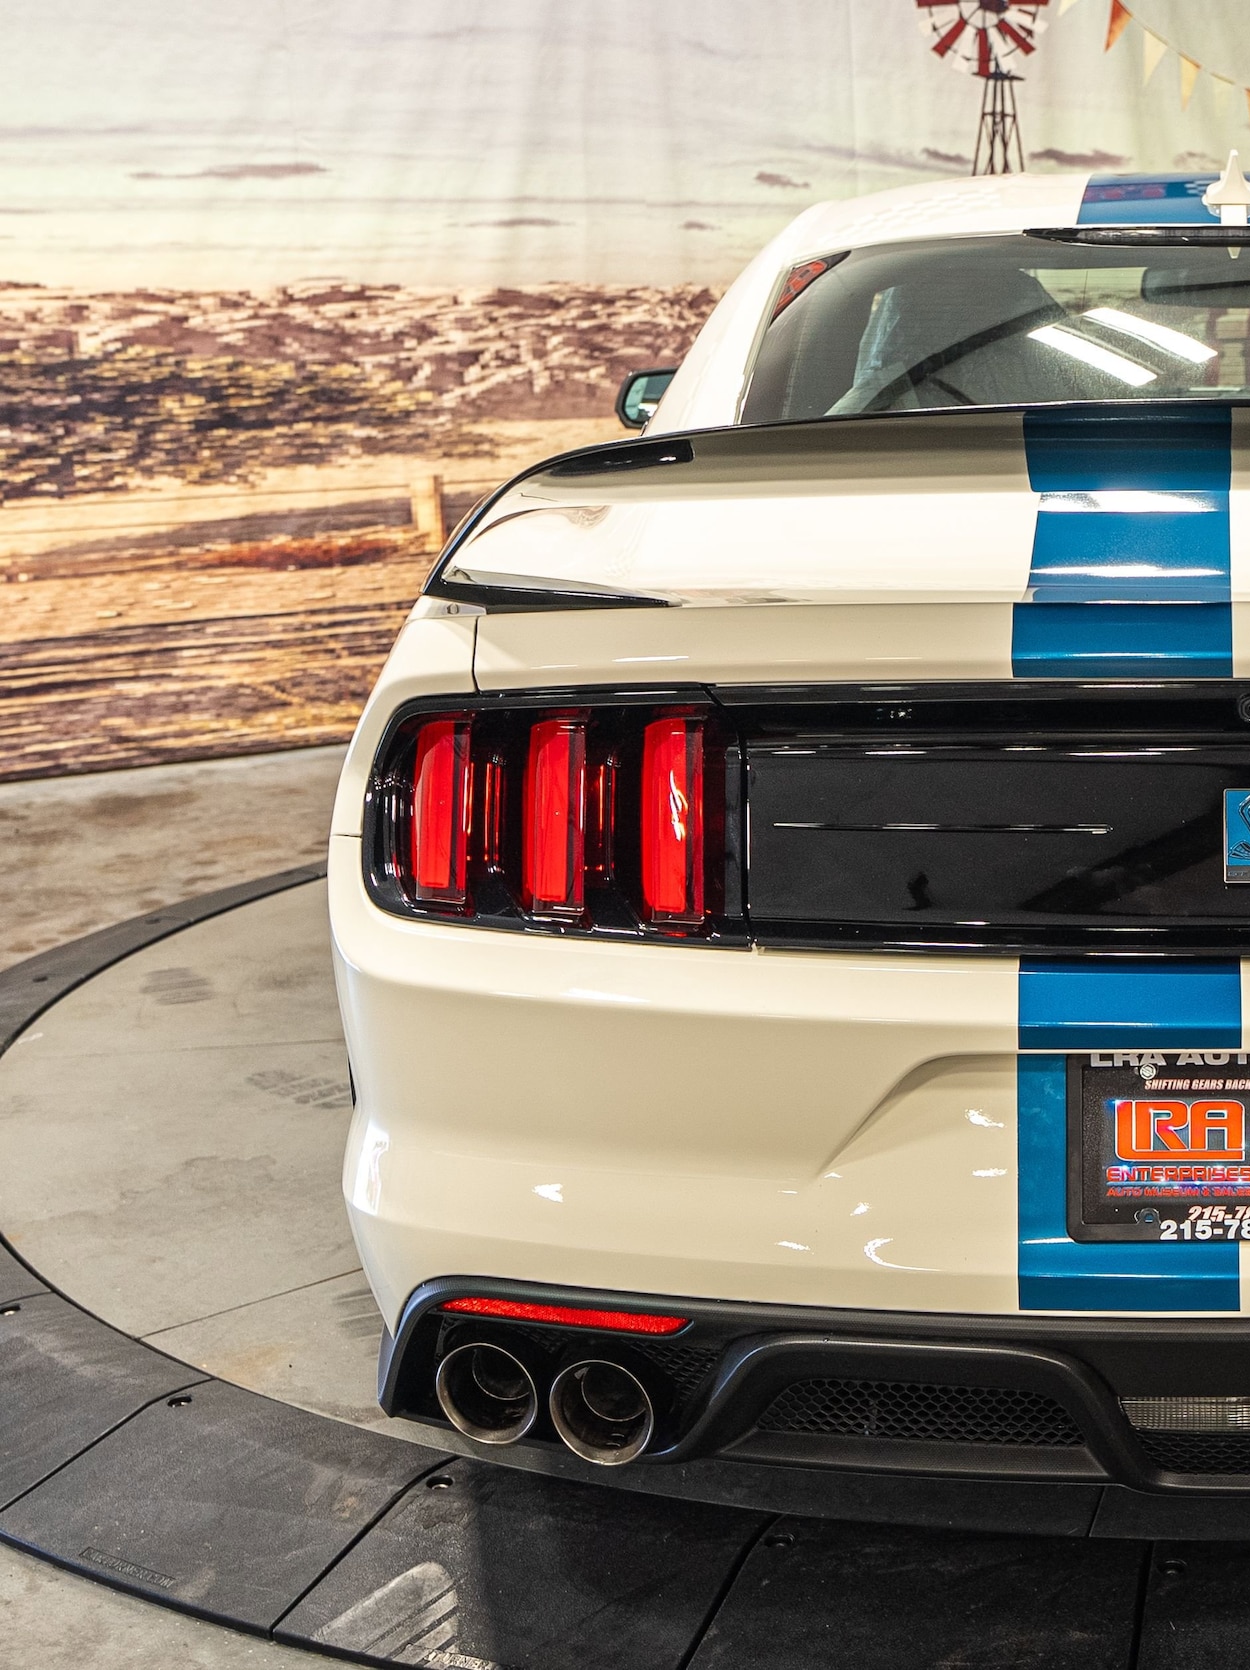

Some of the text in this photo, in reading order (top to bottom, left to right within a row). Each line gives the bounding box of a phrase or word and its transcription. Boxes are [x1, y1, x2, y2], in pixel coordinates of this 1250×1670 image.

[1144, 1079, 1190, 1091] SHIFTING
[1190, 1079, 1224, 1091] GEARS
[1115, 1099, 1246, 1162] LRA
[1106, 1187, 1142, 1197] AUTO
[1144, 1187, 1200, 1197] MUSEUM
